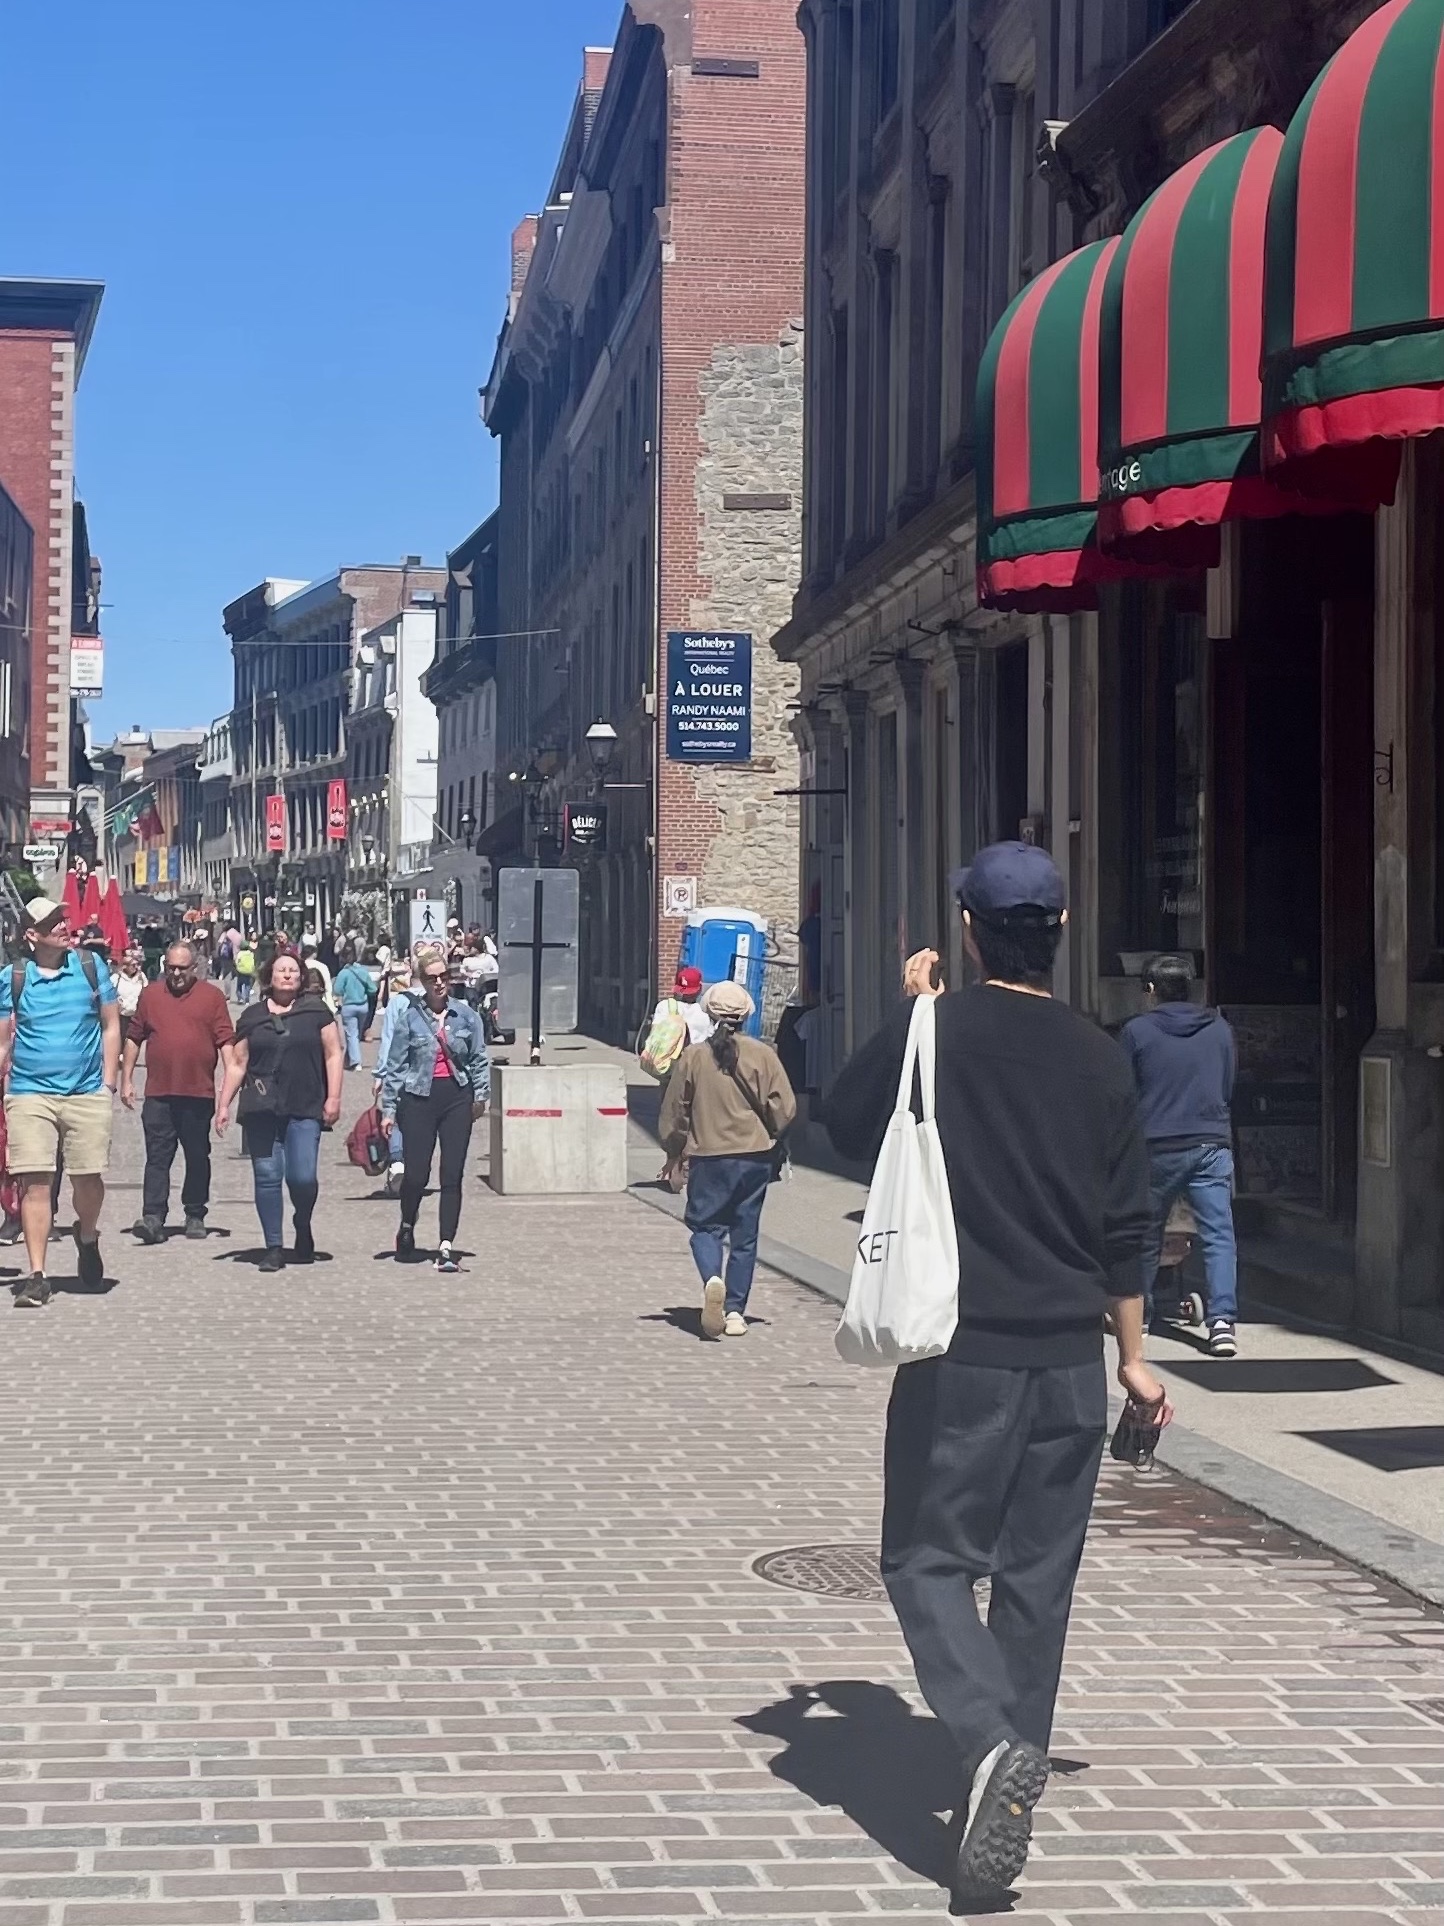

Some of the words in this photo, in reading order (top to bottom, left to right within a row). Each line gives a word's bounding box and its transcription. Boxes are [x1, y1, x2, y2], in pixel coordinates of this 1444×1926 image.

[690, 663, 729, 676] Québec
[675, 681, 685, 696] À
[691, 683, 742, 696] LOUER
[672, 705, 708, 716] RANDY
[710, 705, 746, 716] NAAMI
